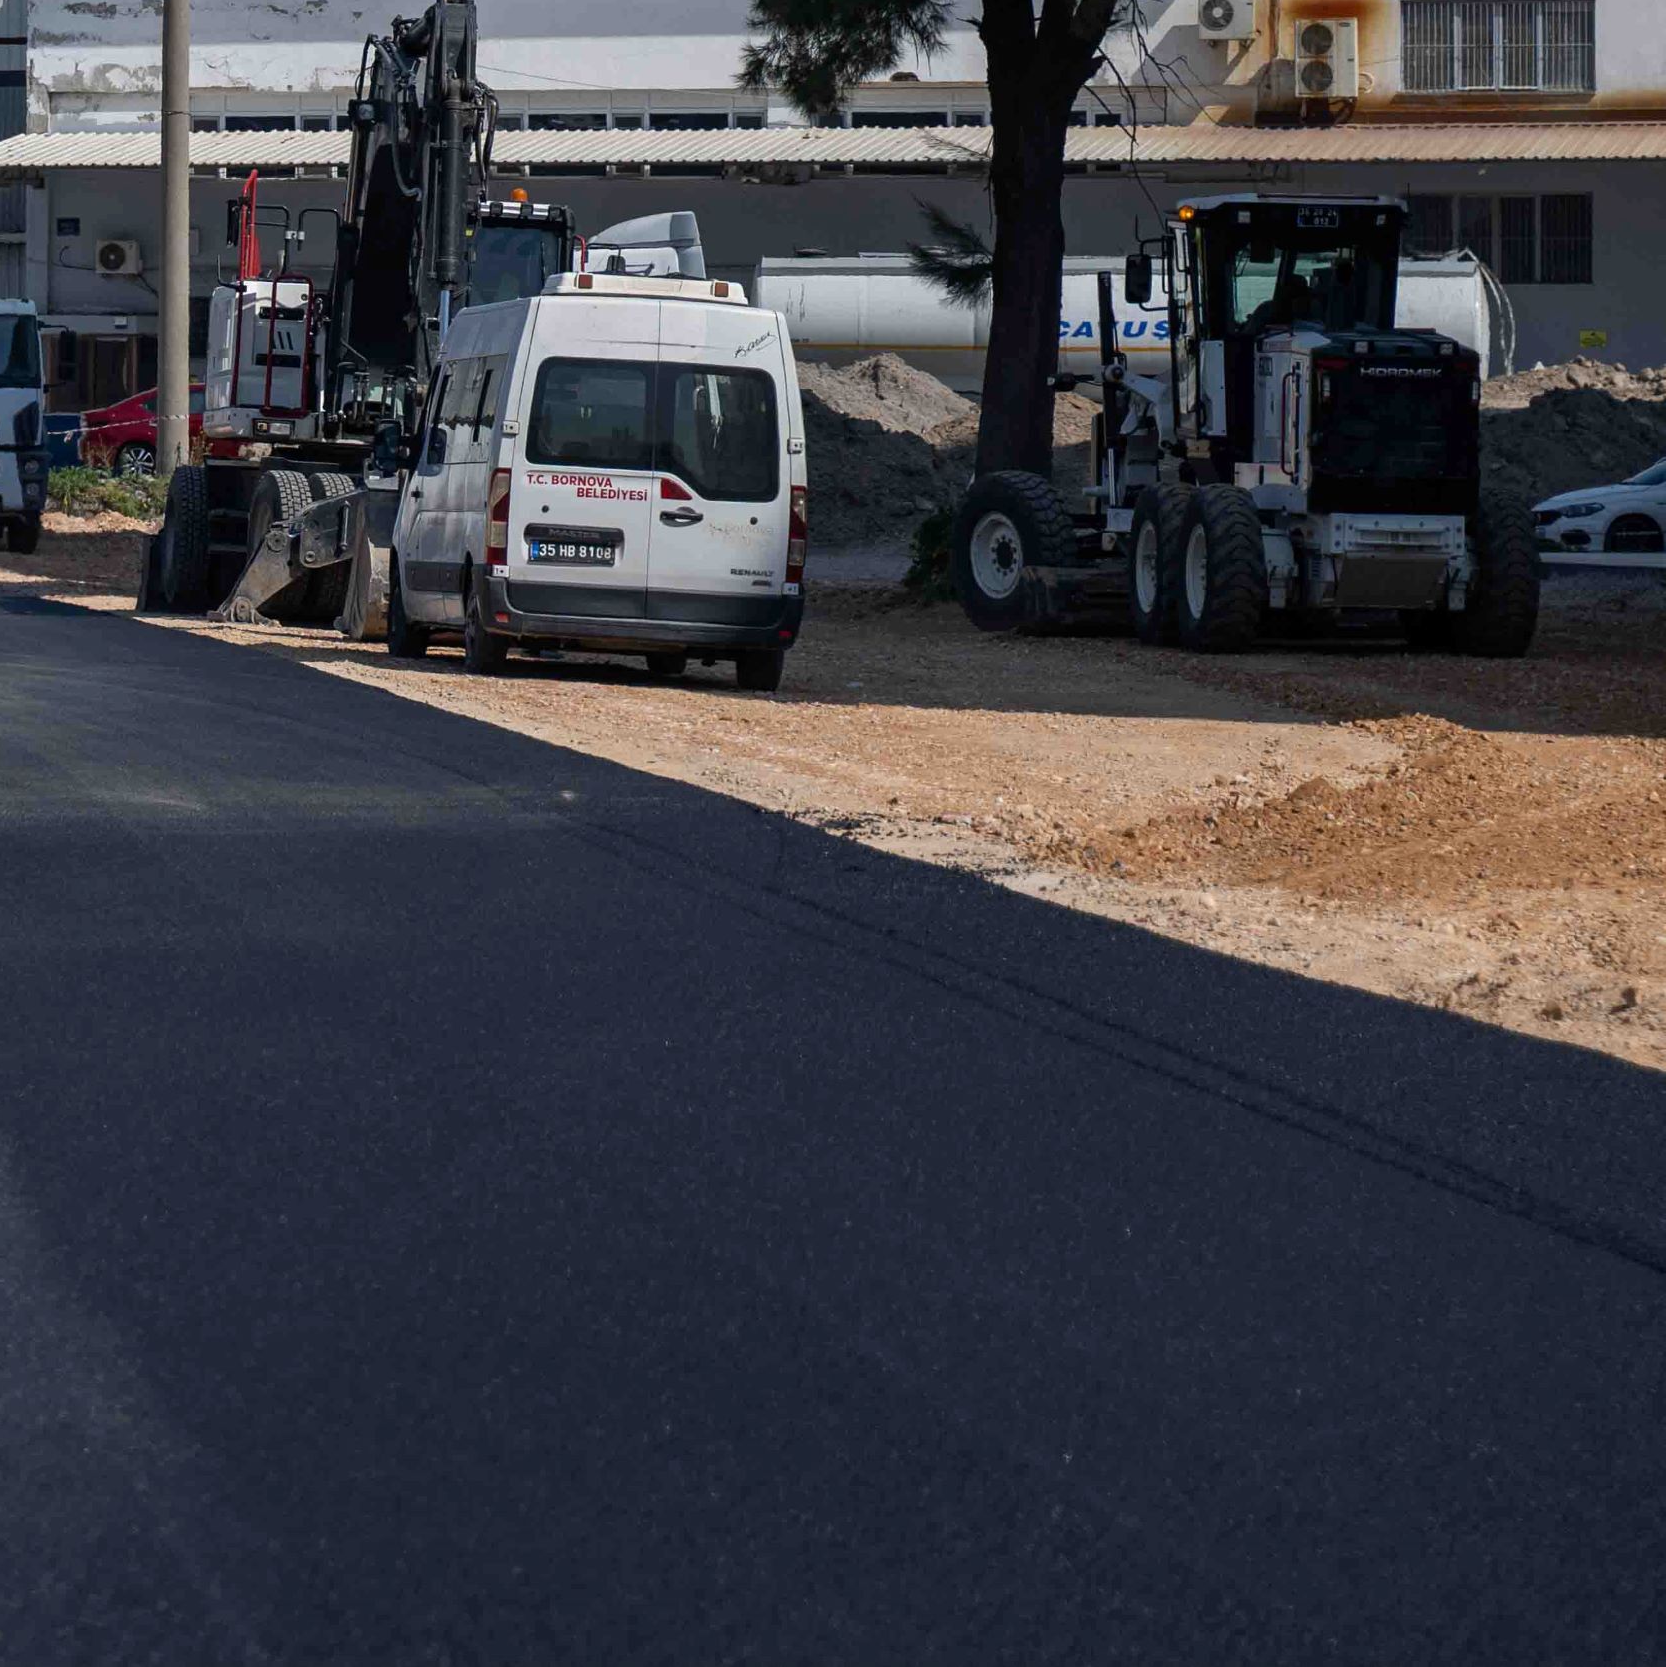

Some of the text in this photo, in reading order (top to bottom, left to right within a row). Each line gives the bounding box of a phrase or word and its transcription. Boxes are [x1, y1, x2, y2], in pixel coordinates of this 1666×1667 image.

[527, 474, 613, 488] T.C. BORNOVA
[576, 487, 648, 502] BELEDİYESİ
[539, 543, 556, 556] 35
[559, 544, 576, 557] HB
